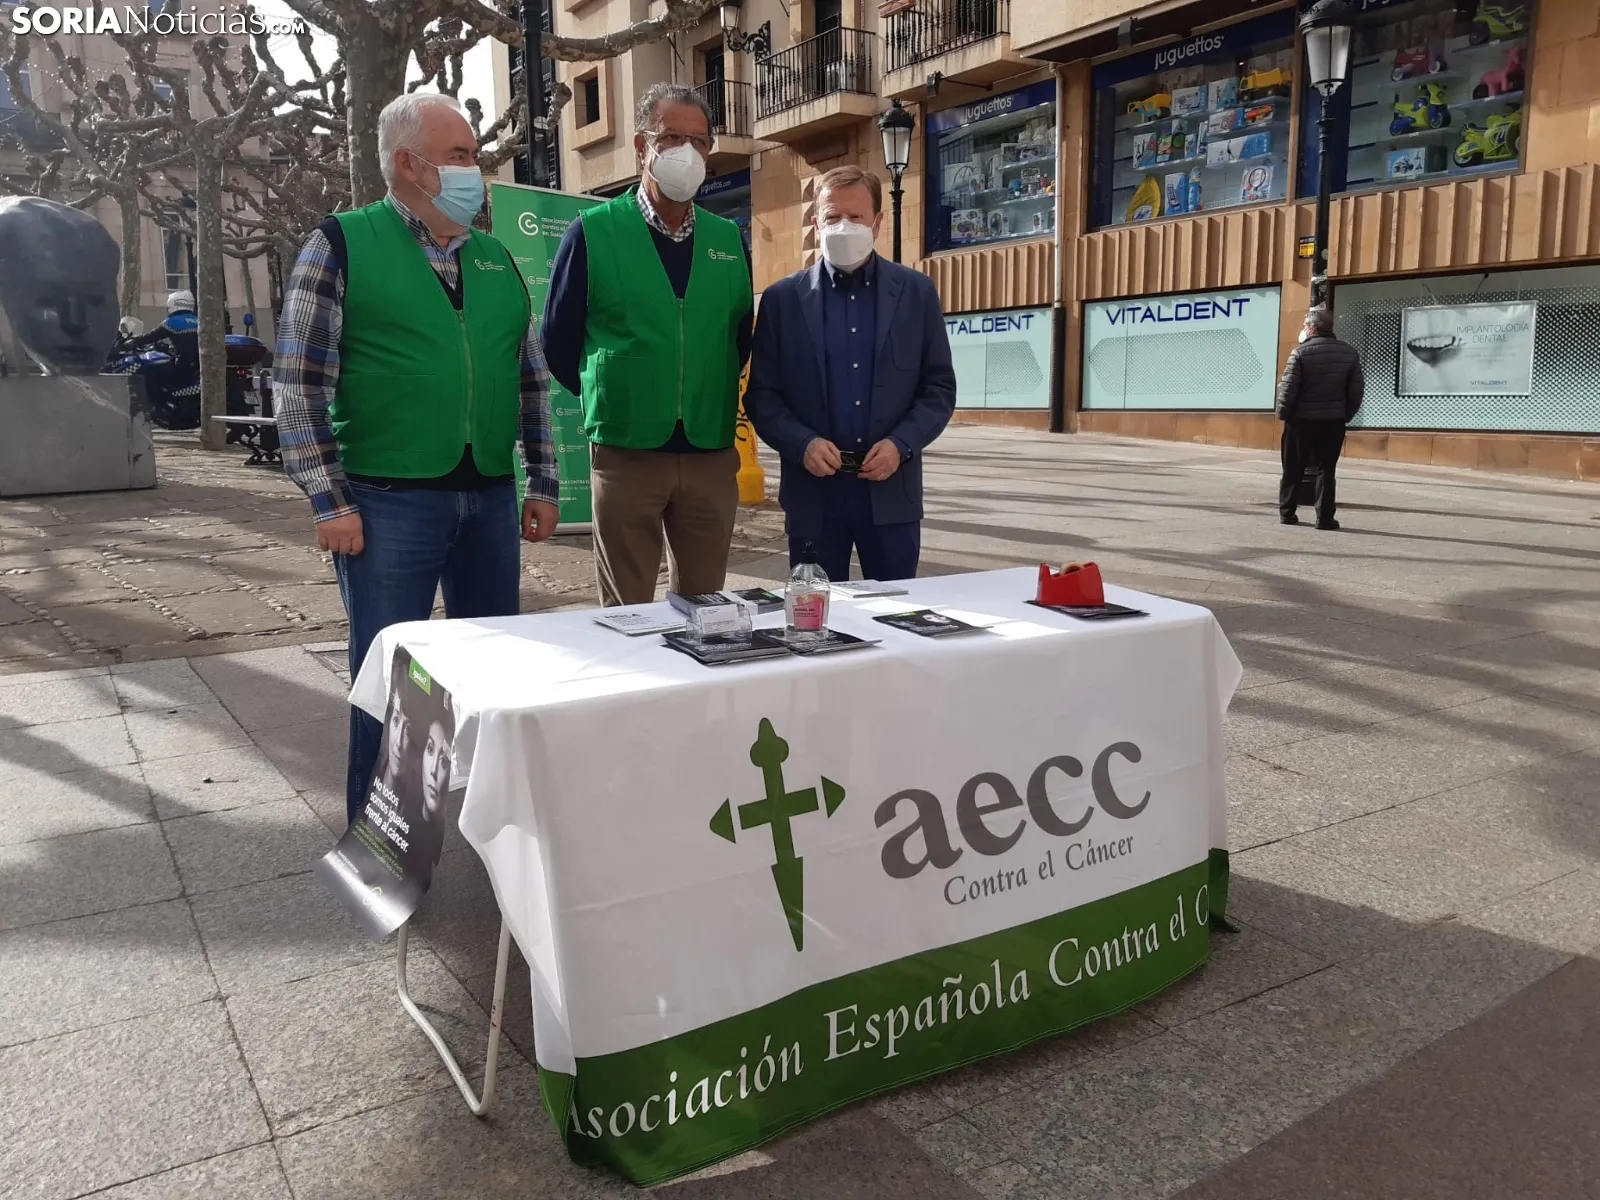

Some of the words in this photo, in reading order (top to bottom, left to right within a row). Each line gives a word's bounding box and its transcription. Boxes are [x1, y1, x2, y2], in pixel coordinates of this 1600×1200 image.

[1155, 35, 1222, 70] juguettos
[964, 96, 1012, 122] juguettos
[946, 314, 1034, 335] TALDENT
[1106, 298, 1250, 326] VITALDENT
[1472, 334, 1508, 343] DENTAL
[373, 776, 383, 791] No
[382, 785, 400, 807] todos
[370, 792, 389, 815] somos
[388, 806, 410, 834] iguales
[873, 741, 1151, 879] aecc
[364, 803, 383, 826] frente
[380, 819, 389, 833] al
[387, 827, 409, 853] cáncer.
[943, 866, 1028, 905] Contra
[1038, 850, 1055, 880] el
[1065, 835, 1134, 871] Cáncer
[823, 959, 1031, 1063] Española
[1048, 920, 1160, 988] Contra
[1168, 895, 1187, 943] el
